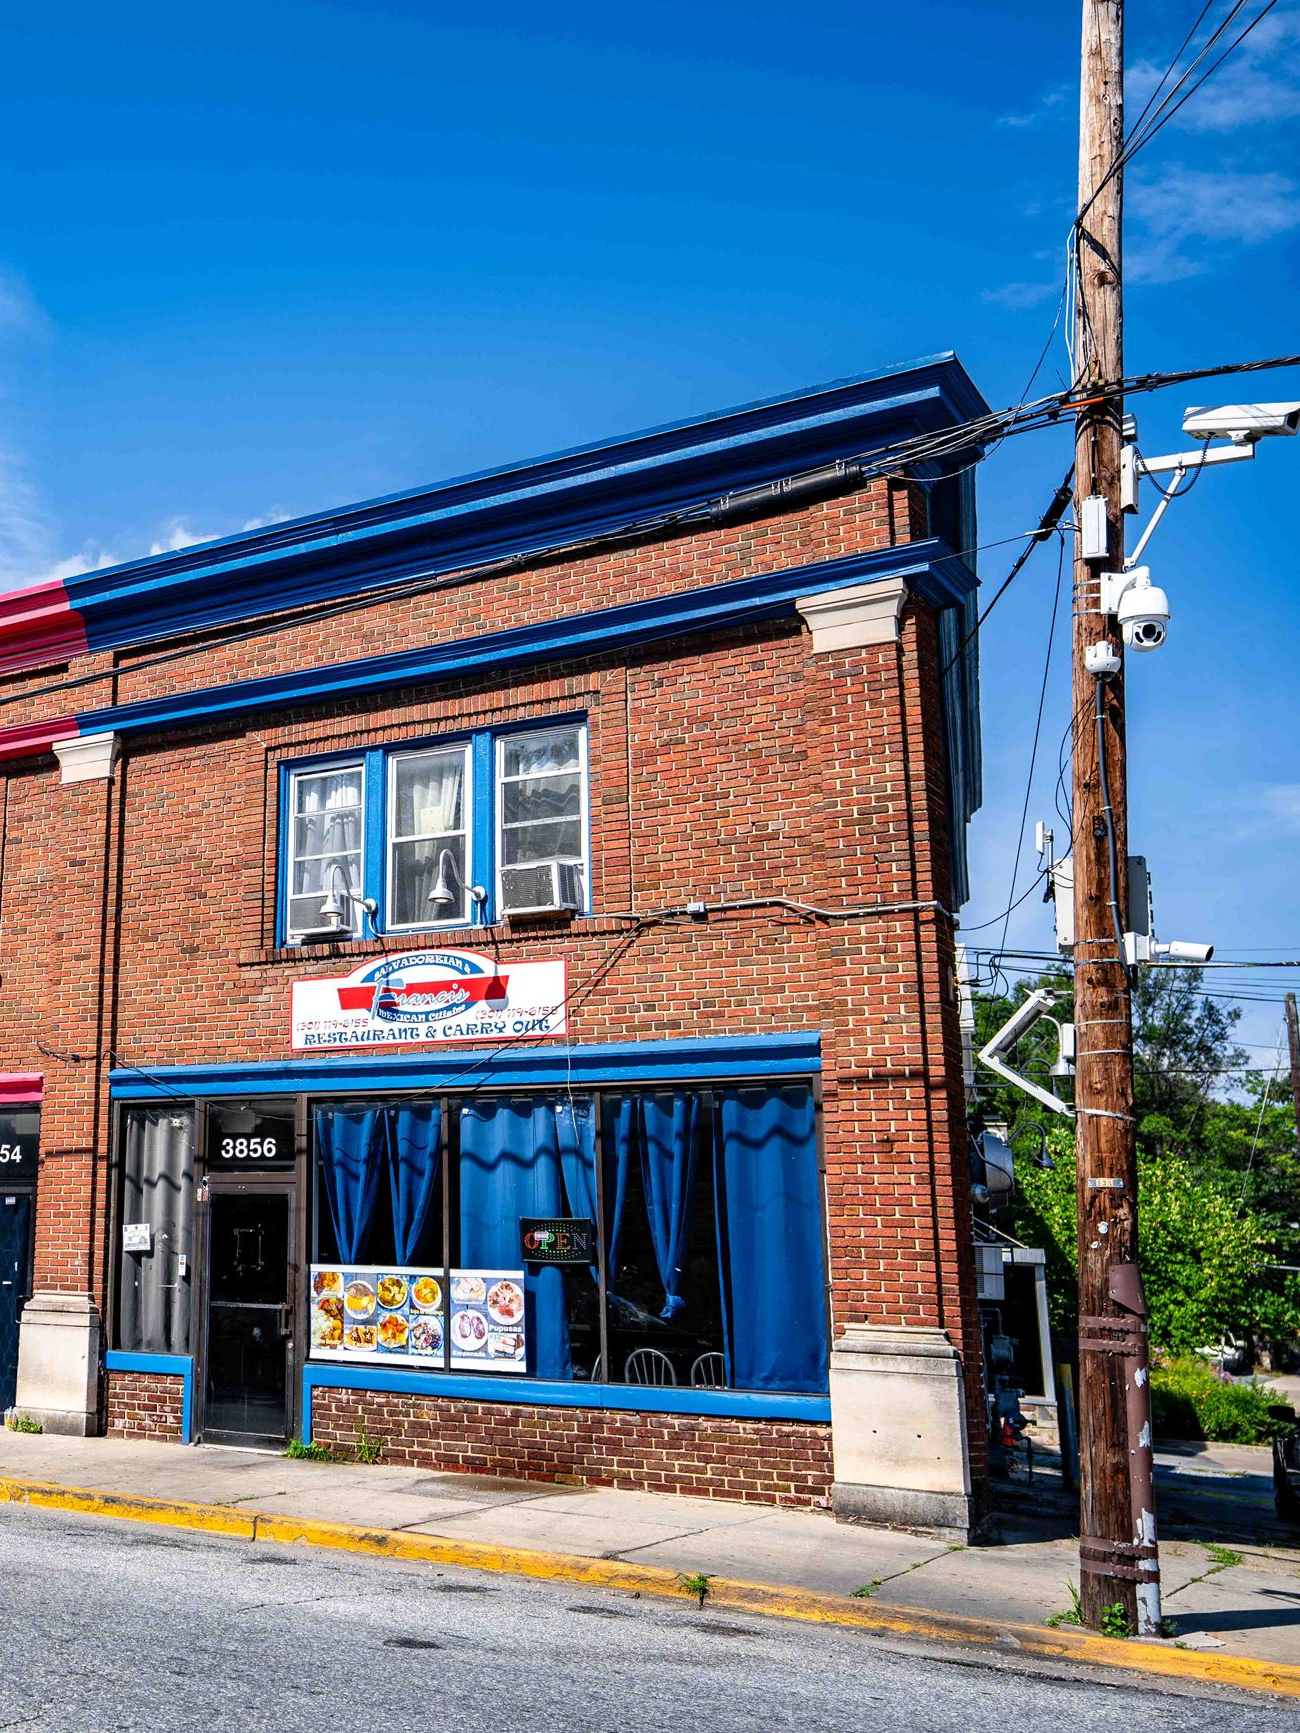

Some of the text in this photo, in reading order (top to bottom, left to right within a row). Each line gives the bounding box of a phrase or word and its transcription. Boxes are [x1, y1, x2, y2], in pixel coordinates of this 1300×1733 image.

[371, 978, 470, 1021] Francis
[379, 1008, 426, 1023] MEXICAN
[303, 1018, 551, 1046] RESTAURANT & CARRY OUT
[221, 1137, 277, 1158] 3856
[524, 1231, 588, 1251] OPEN
[488, 1324, 522, 1333] Pupusas
